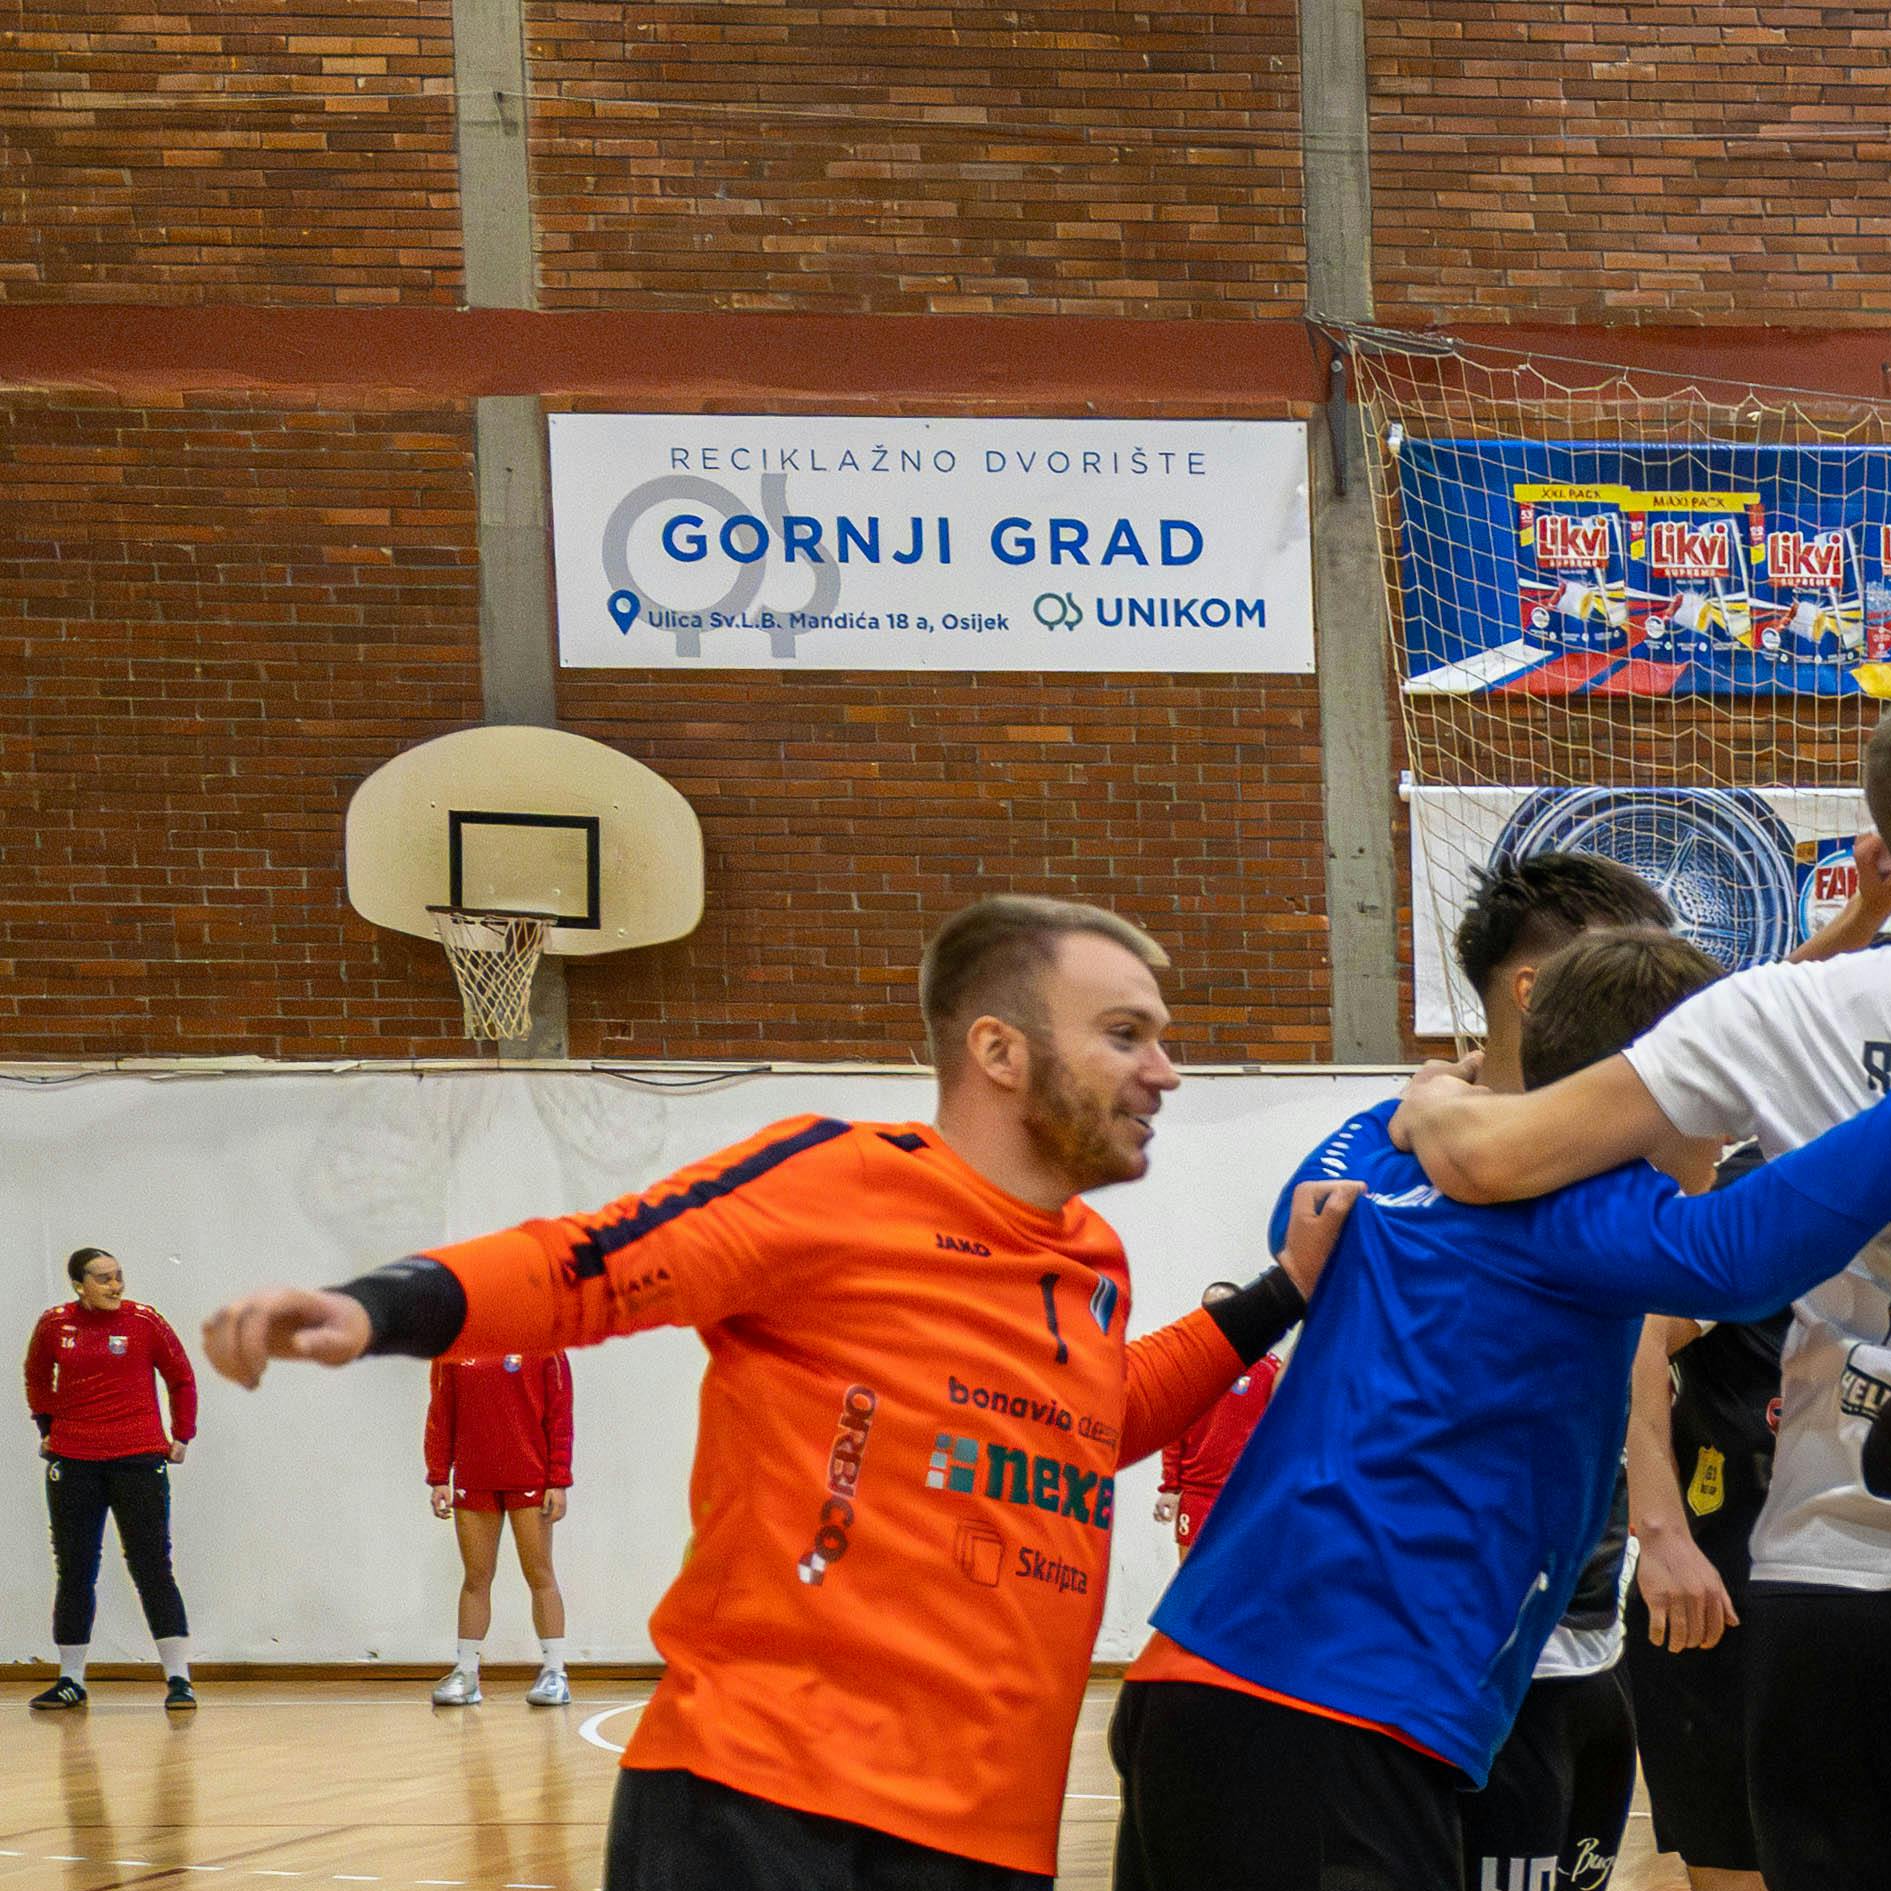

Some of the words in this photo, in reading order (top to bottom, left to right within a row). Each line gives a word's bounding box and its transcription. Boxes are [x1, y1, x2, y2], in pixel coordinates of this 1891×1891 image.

[670, 442, 958, 474] RECIKLAŽNO
[986, 444, 1208, 476] DVORIŠTE
[661, 515, 951, 566] GORNJI
[989, 517, 1205, 567] GRAD
[1538, 514, 1610, 559] Likvi
[1652, 521, 1730, 568] Likvi
[1768, 531, 1844, 577] Likvi
[648, 610, 704, 631] Ulica
[789, 611, 881, 632] Mandića
[886, 612, 910, 631] 18
[941, 611, 1010, 636] Osijek
[1096, 598, 1266, 629] UNIKOM
[948, 1375, 1072, 1432] bonavia
[1015, 1546, 1088, 1596] Skripta
